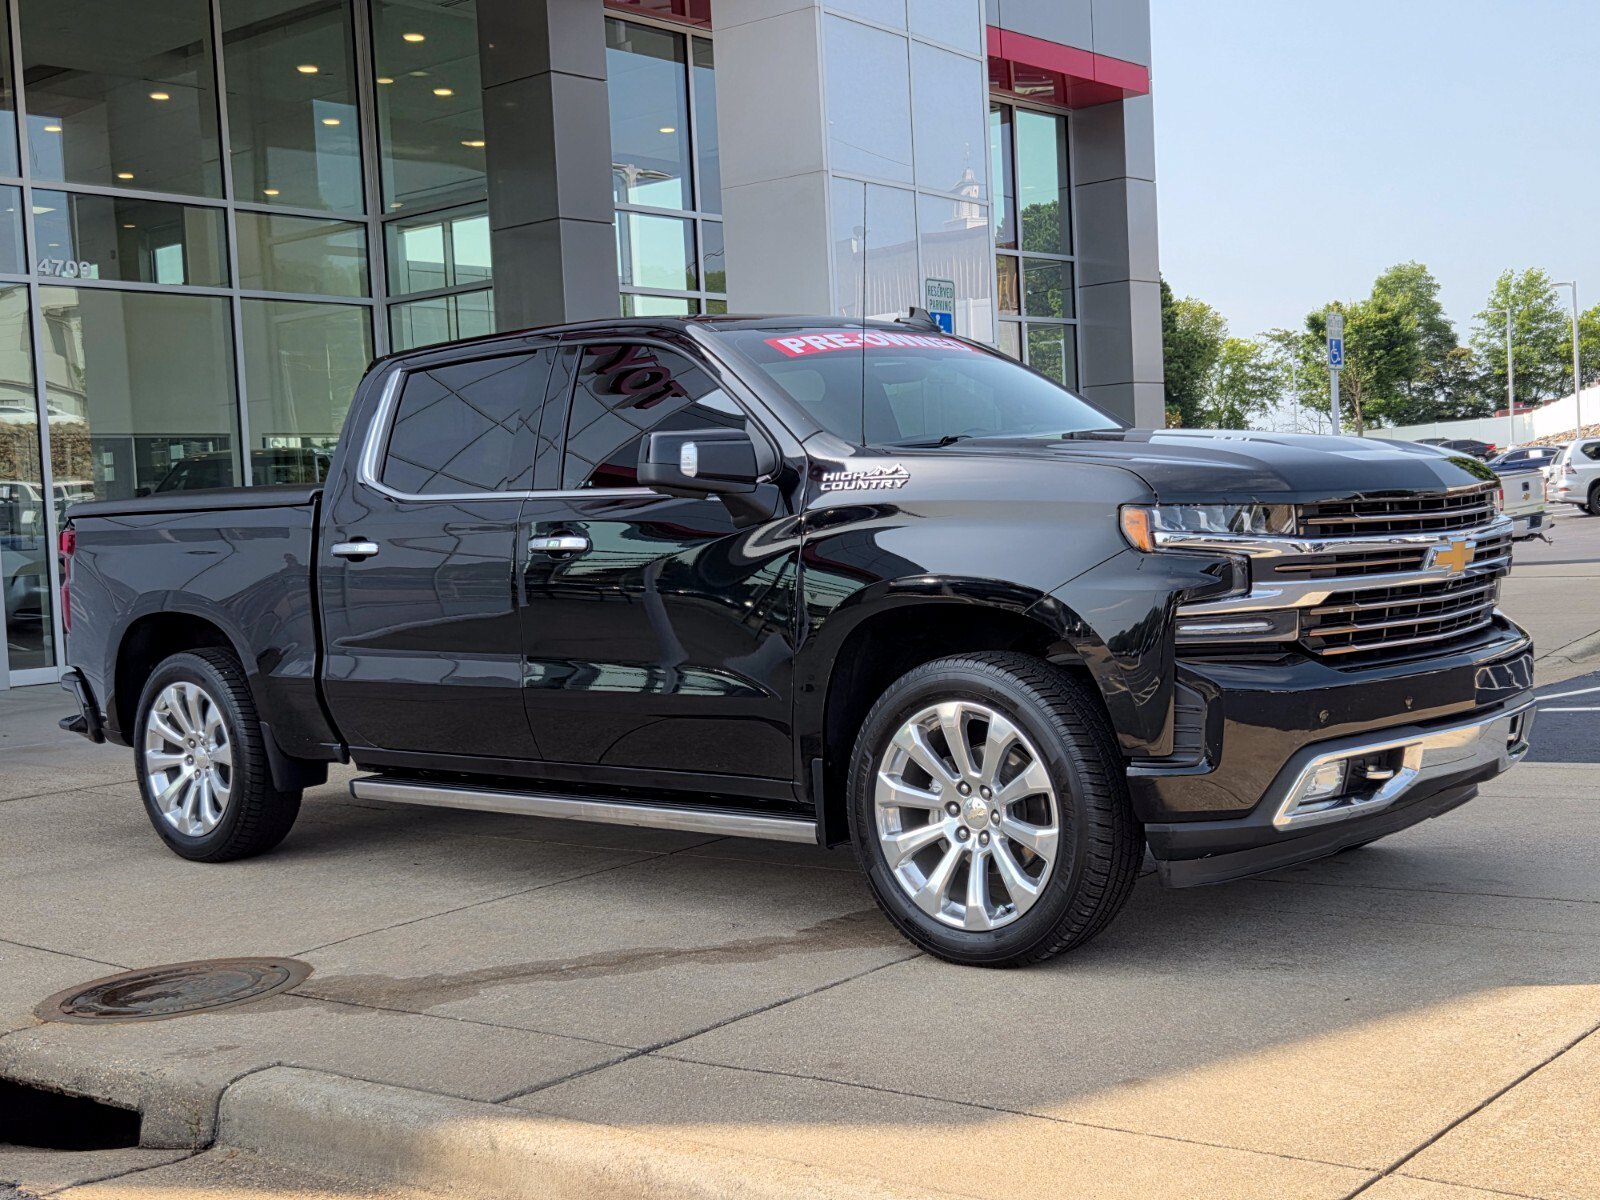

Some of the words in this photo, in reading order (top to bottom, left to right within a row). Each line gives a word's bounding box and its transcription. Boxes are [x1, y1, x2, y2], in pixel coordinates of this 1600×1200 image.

[38, 259, 91, 277] 4709
[928, 285, 953, 299] RESERVED
[929, 299, 952, 311] PARKING
[777, 333, 972, 354] PRE-OWNED
[822, 472, 866, 481] HIGH
[820, 480, 908, 491] COUNTRY
